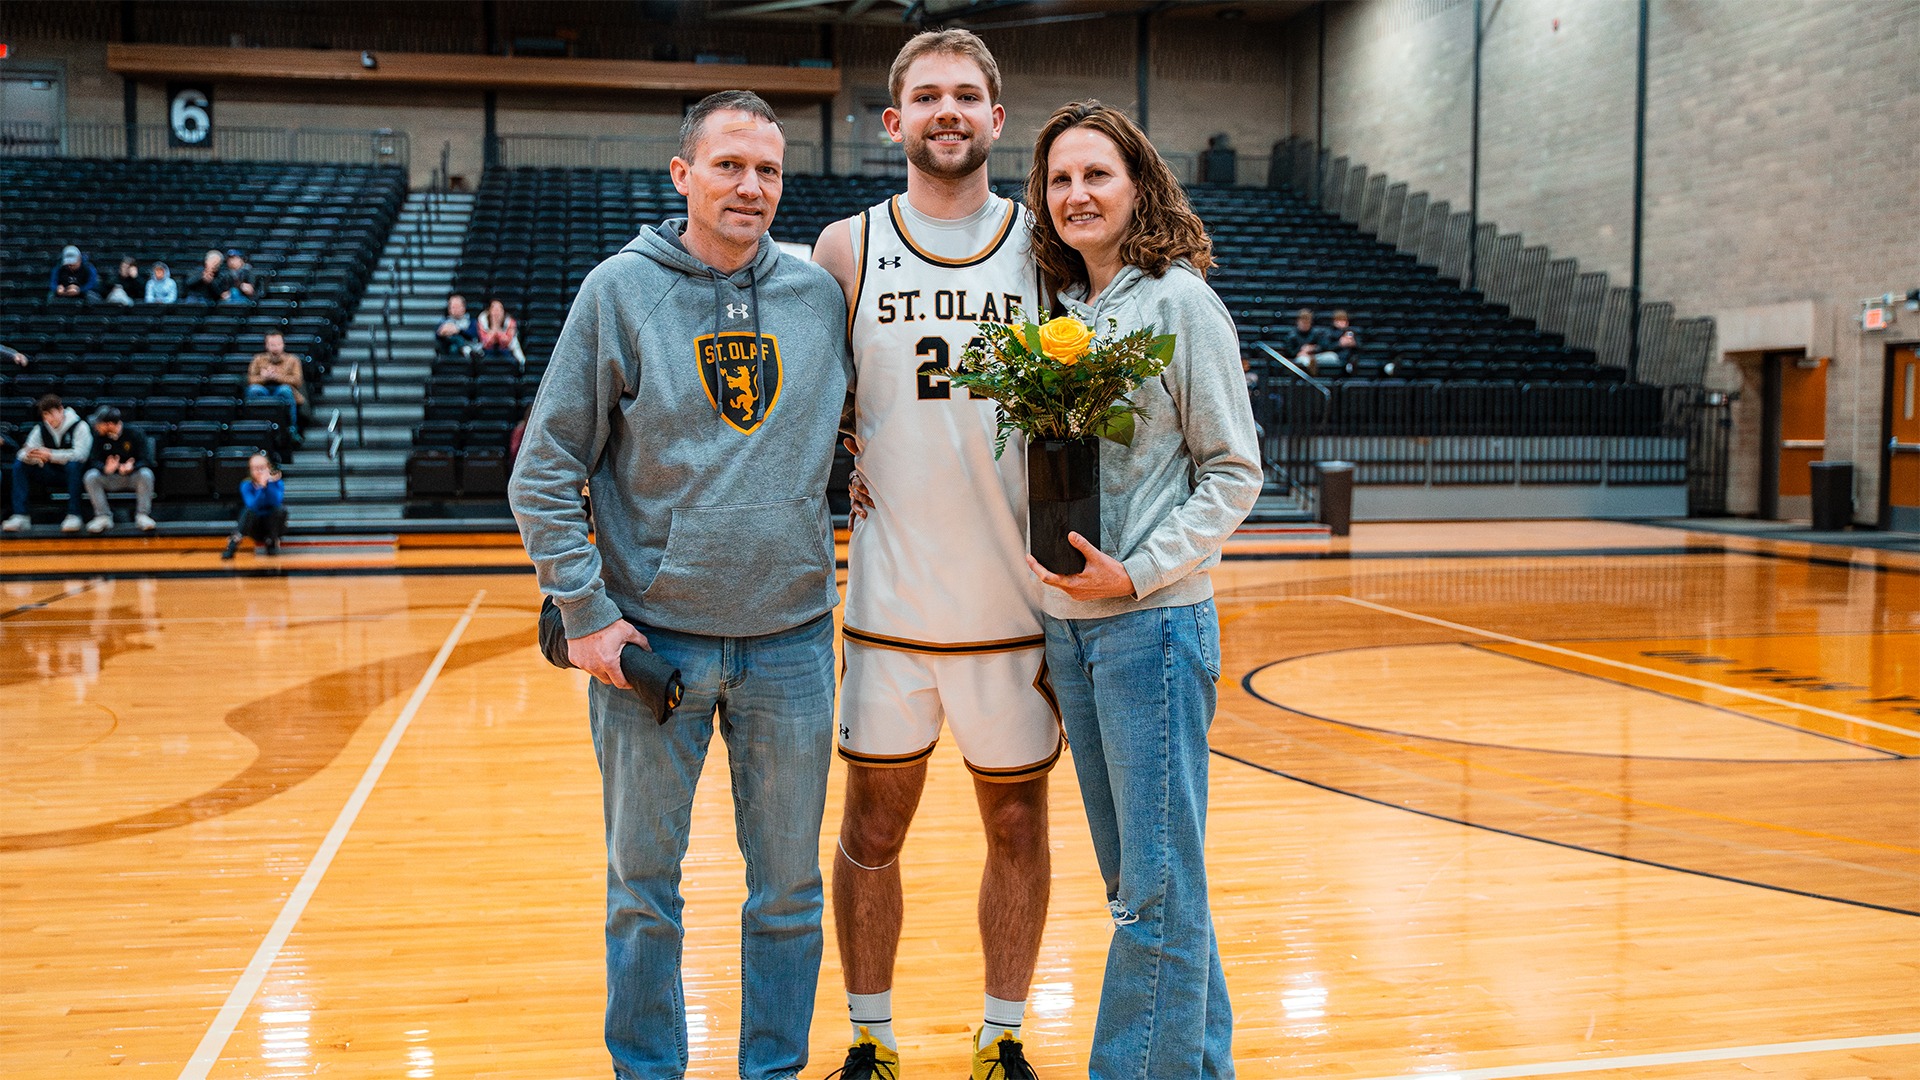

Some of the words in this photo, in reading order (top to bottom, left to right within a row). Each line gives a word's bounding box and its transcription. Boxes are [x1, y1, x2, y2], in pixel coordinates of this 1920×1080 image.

[171, 88, 210, 144] 6
[878, 289, 927, 325] ST.
[935, 289, 1023, 325] OLAF
[704, 343, 728, 365] ST.
[728, 341, 770, 361] OLAF
